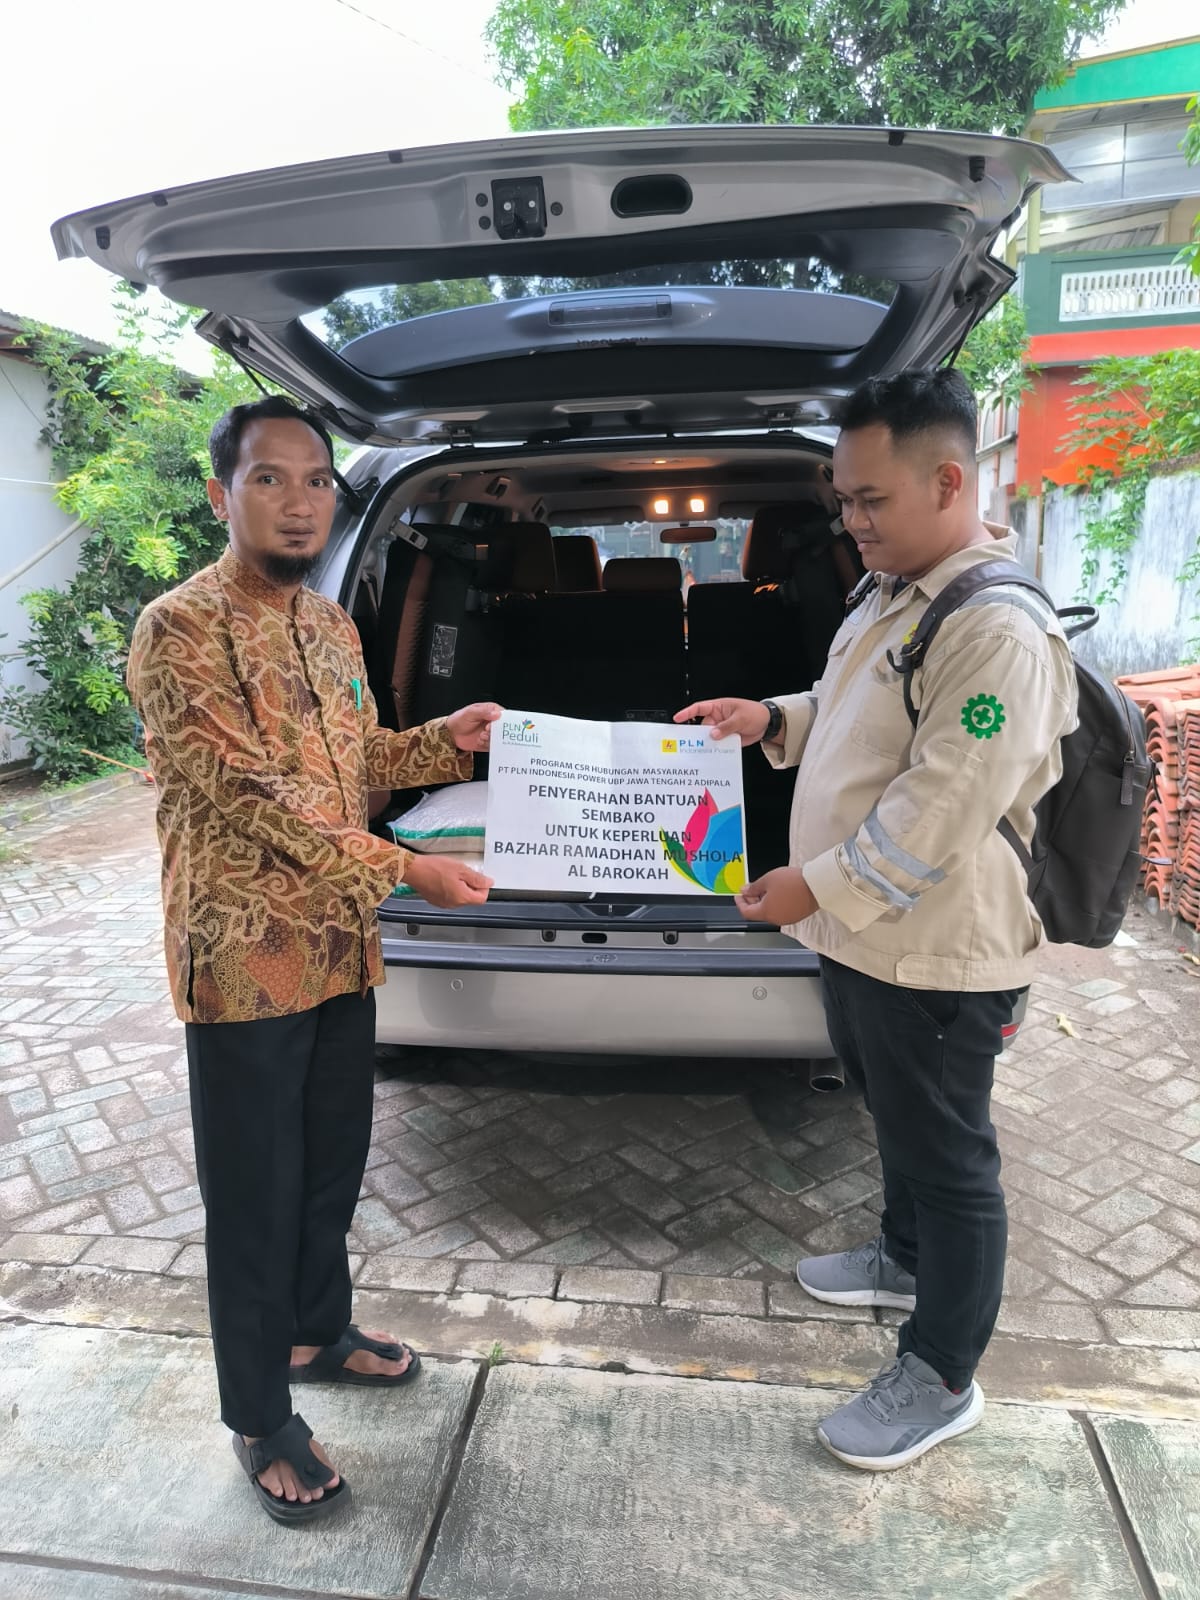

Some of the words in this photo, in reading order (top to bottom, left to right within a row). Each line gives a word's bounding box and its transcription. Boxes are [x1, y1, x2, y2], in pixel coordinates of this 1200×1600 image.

[503, 722, 521, 732] PLN
[502, 730, 538, 743] Peduli
[530, 758, 572, 769] PROGRAM
[574, 764, 590, 772] CSR
[592, 766, 640, 776] HUBUNGAN
[530, 768, 576, 780] INDONESIA
[578, 774, 606, 784] POWER
[608, 776, 624, 785] UBP
[528, 784, 630, 805] PENYERAHAN
[634, 794, 708, 806] BANTUAN
[582, 808, 655, 824] SEMBAKO
[546, 824, 599, 840] UNTUK
[602, 829, 692, 842] KEPERLUAN
[494, 842, 558, 856] BAZHAR
[564, 844, 655, 860] RAMADHAN
[664, 849, 742, 862] MUSHOLA
[568, 864, 588, 878] AL
[592, 866, 668, 880] BAROKAH
